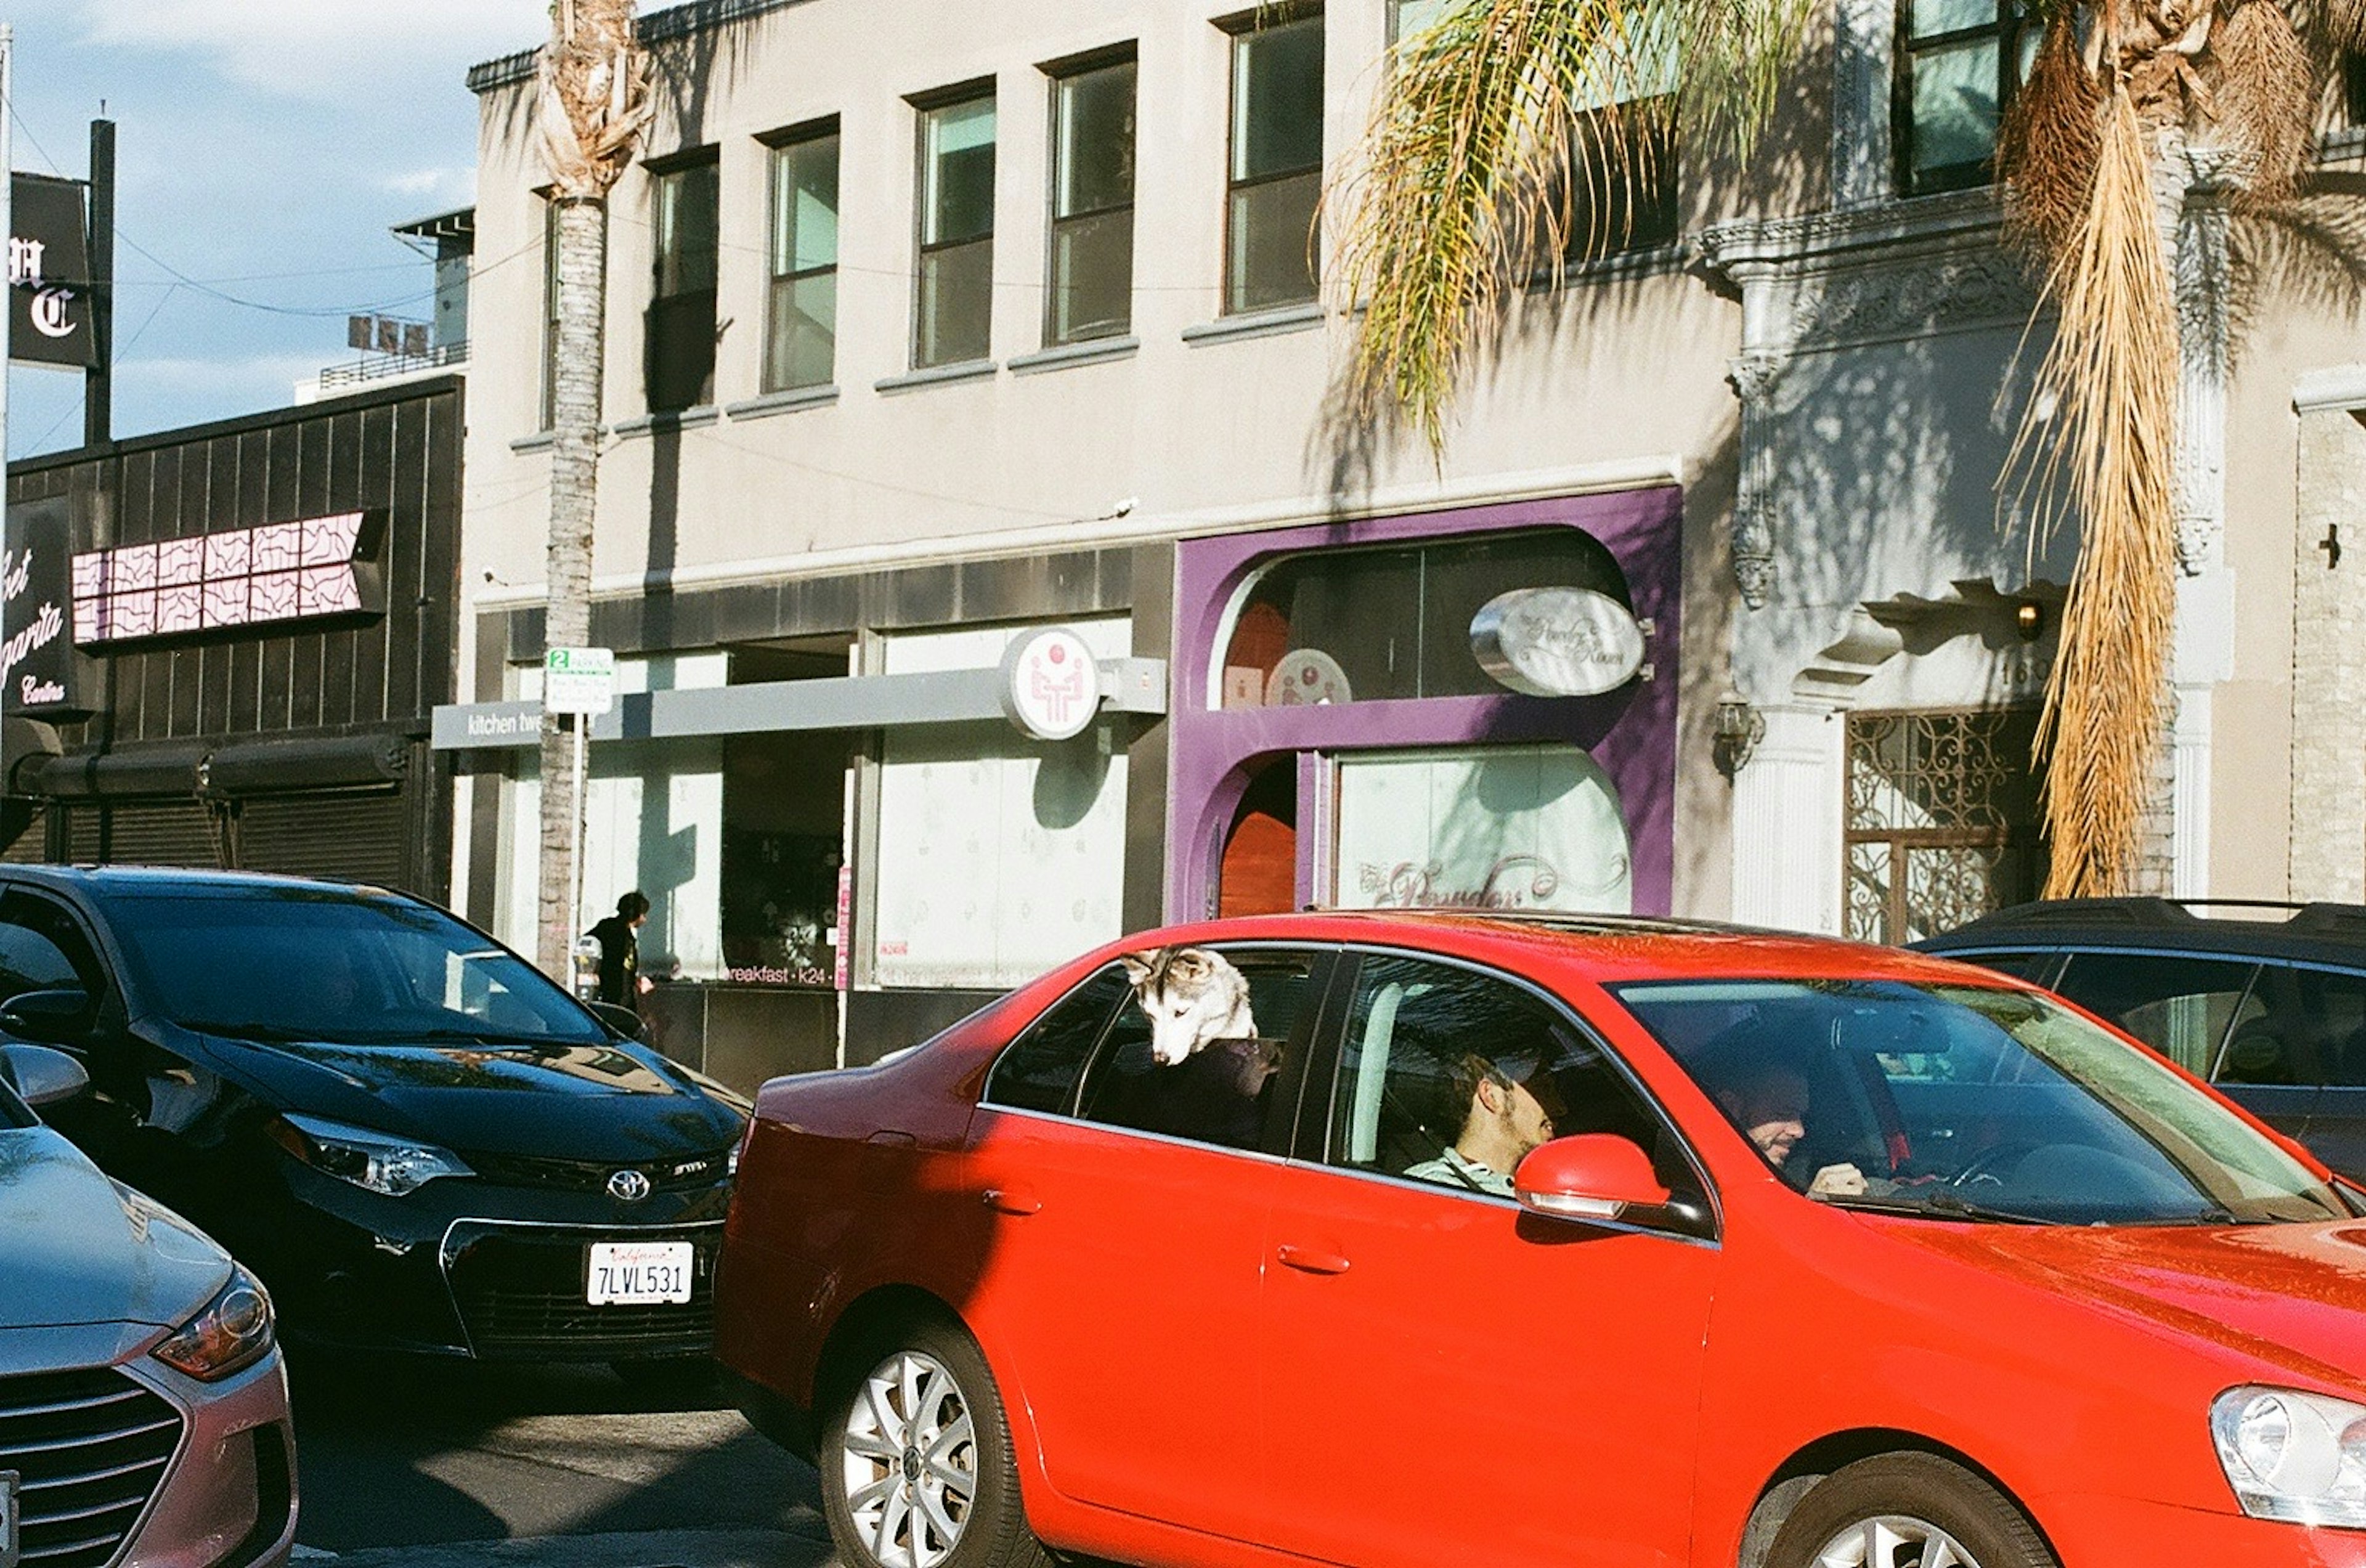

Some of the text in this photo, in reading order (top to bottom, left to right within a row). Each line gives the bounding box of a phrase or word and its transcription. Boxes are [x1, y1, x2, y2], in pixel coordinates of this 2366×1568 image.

[2, 601, 63, 689] garita
[555, 652, 566, 667] 2
[468, 713, 516, 735] kitchen
[799, 966, 825, 985] k24
[611, 1248, 670, 1264] California
[598, 1266, 683, 1294] 7LVL531
